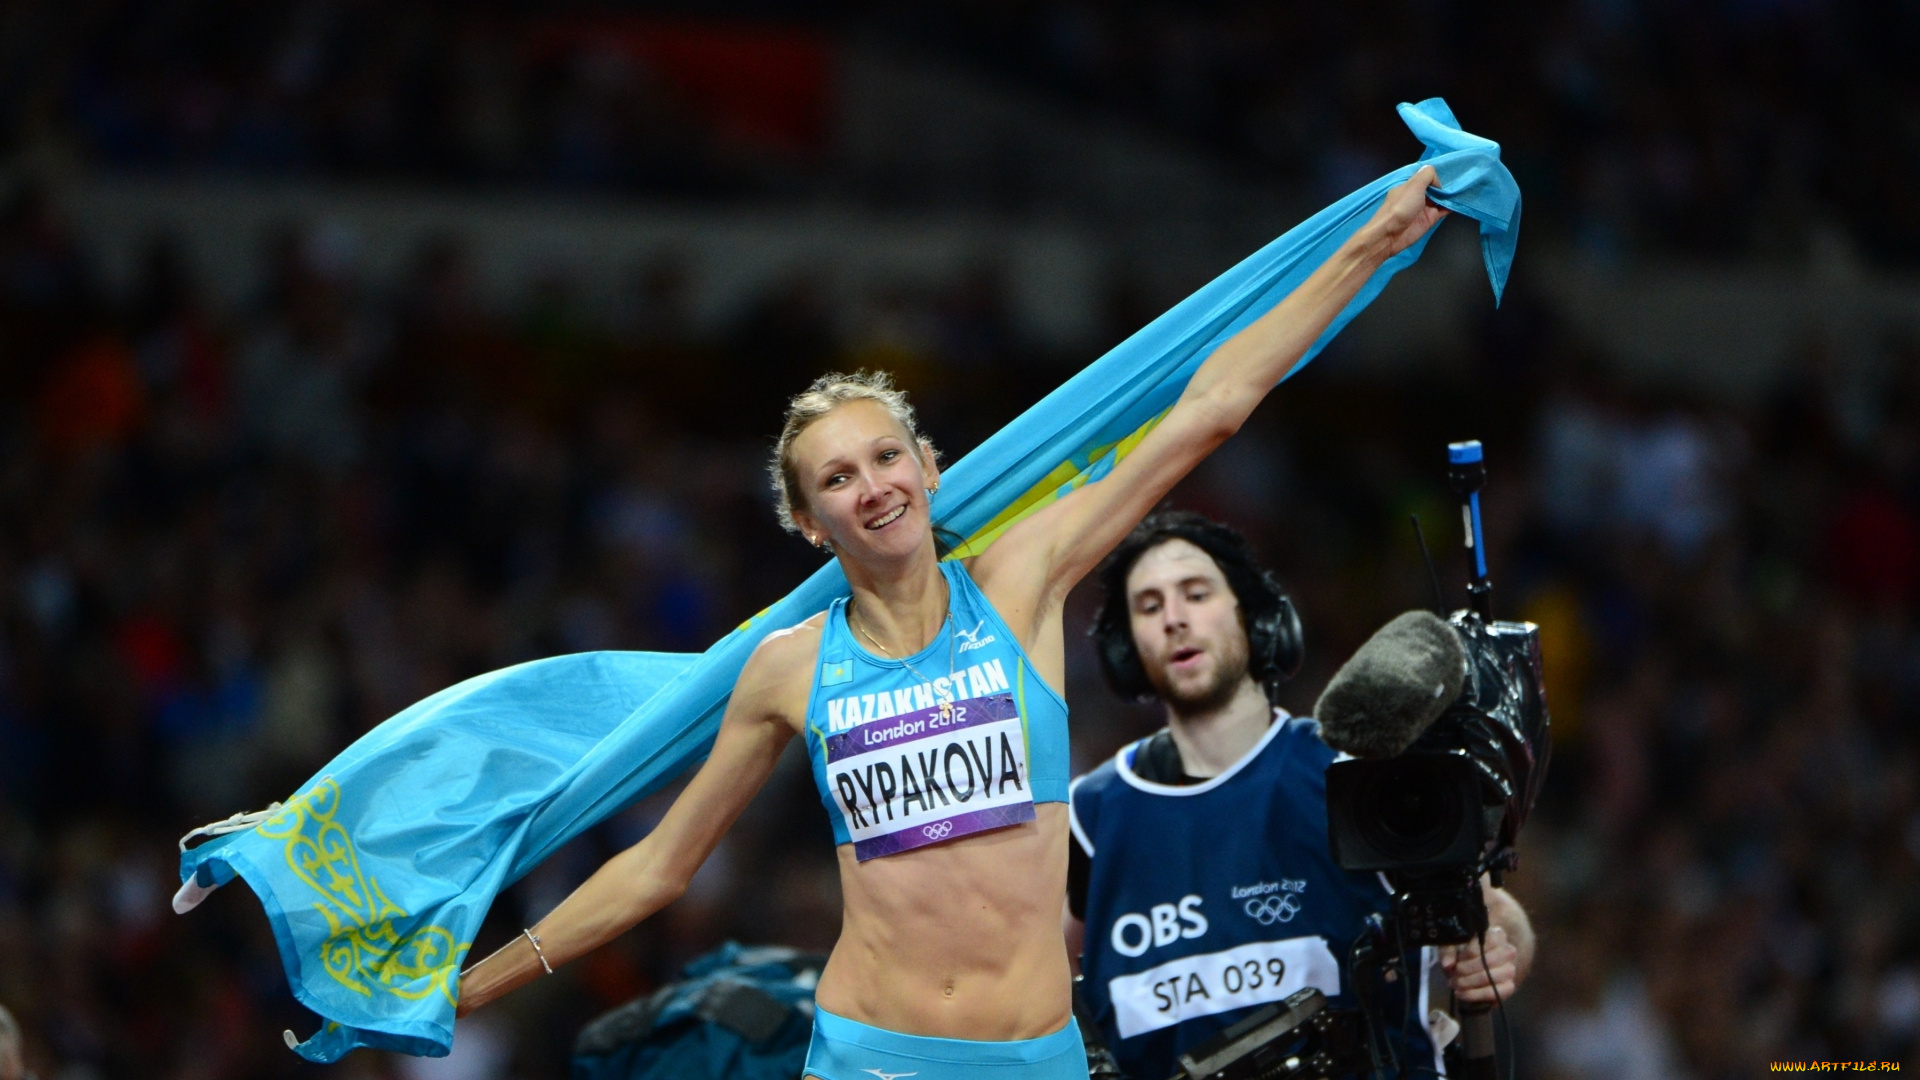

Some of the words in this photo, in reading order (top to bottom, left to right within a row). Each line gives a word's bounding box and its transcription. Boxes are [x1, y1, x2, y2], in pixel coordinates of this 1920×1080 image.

[827, 658, 1009, 733] KAZAKHSTAN
[864, 719, 925, 745] London
[836, 731, 1023, 829] RYPAKOVA
[1231, 882, 1279, 898] London
[1111, 895, 1208, 957] OBS
[1153, 973, 1210, 1012] STA
[1223, 958, 1285, 994] 039
